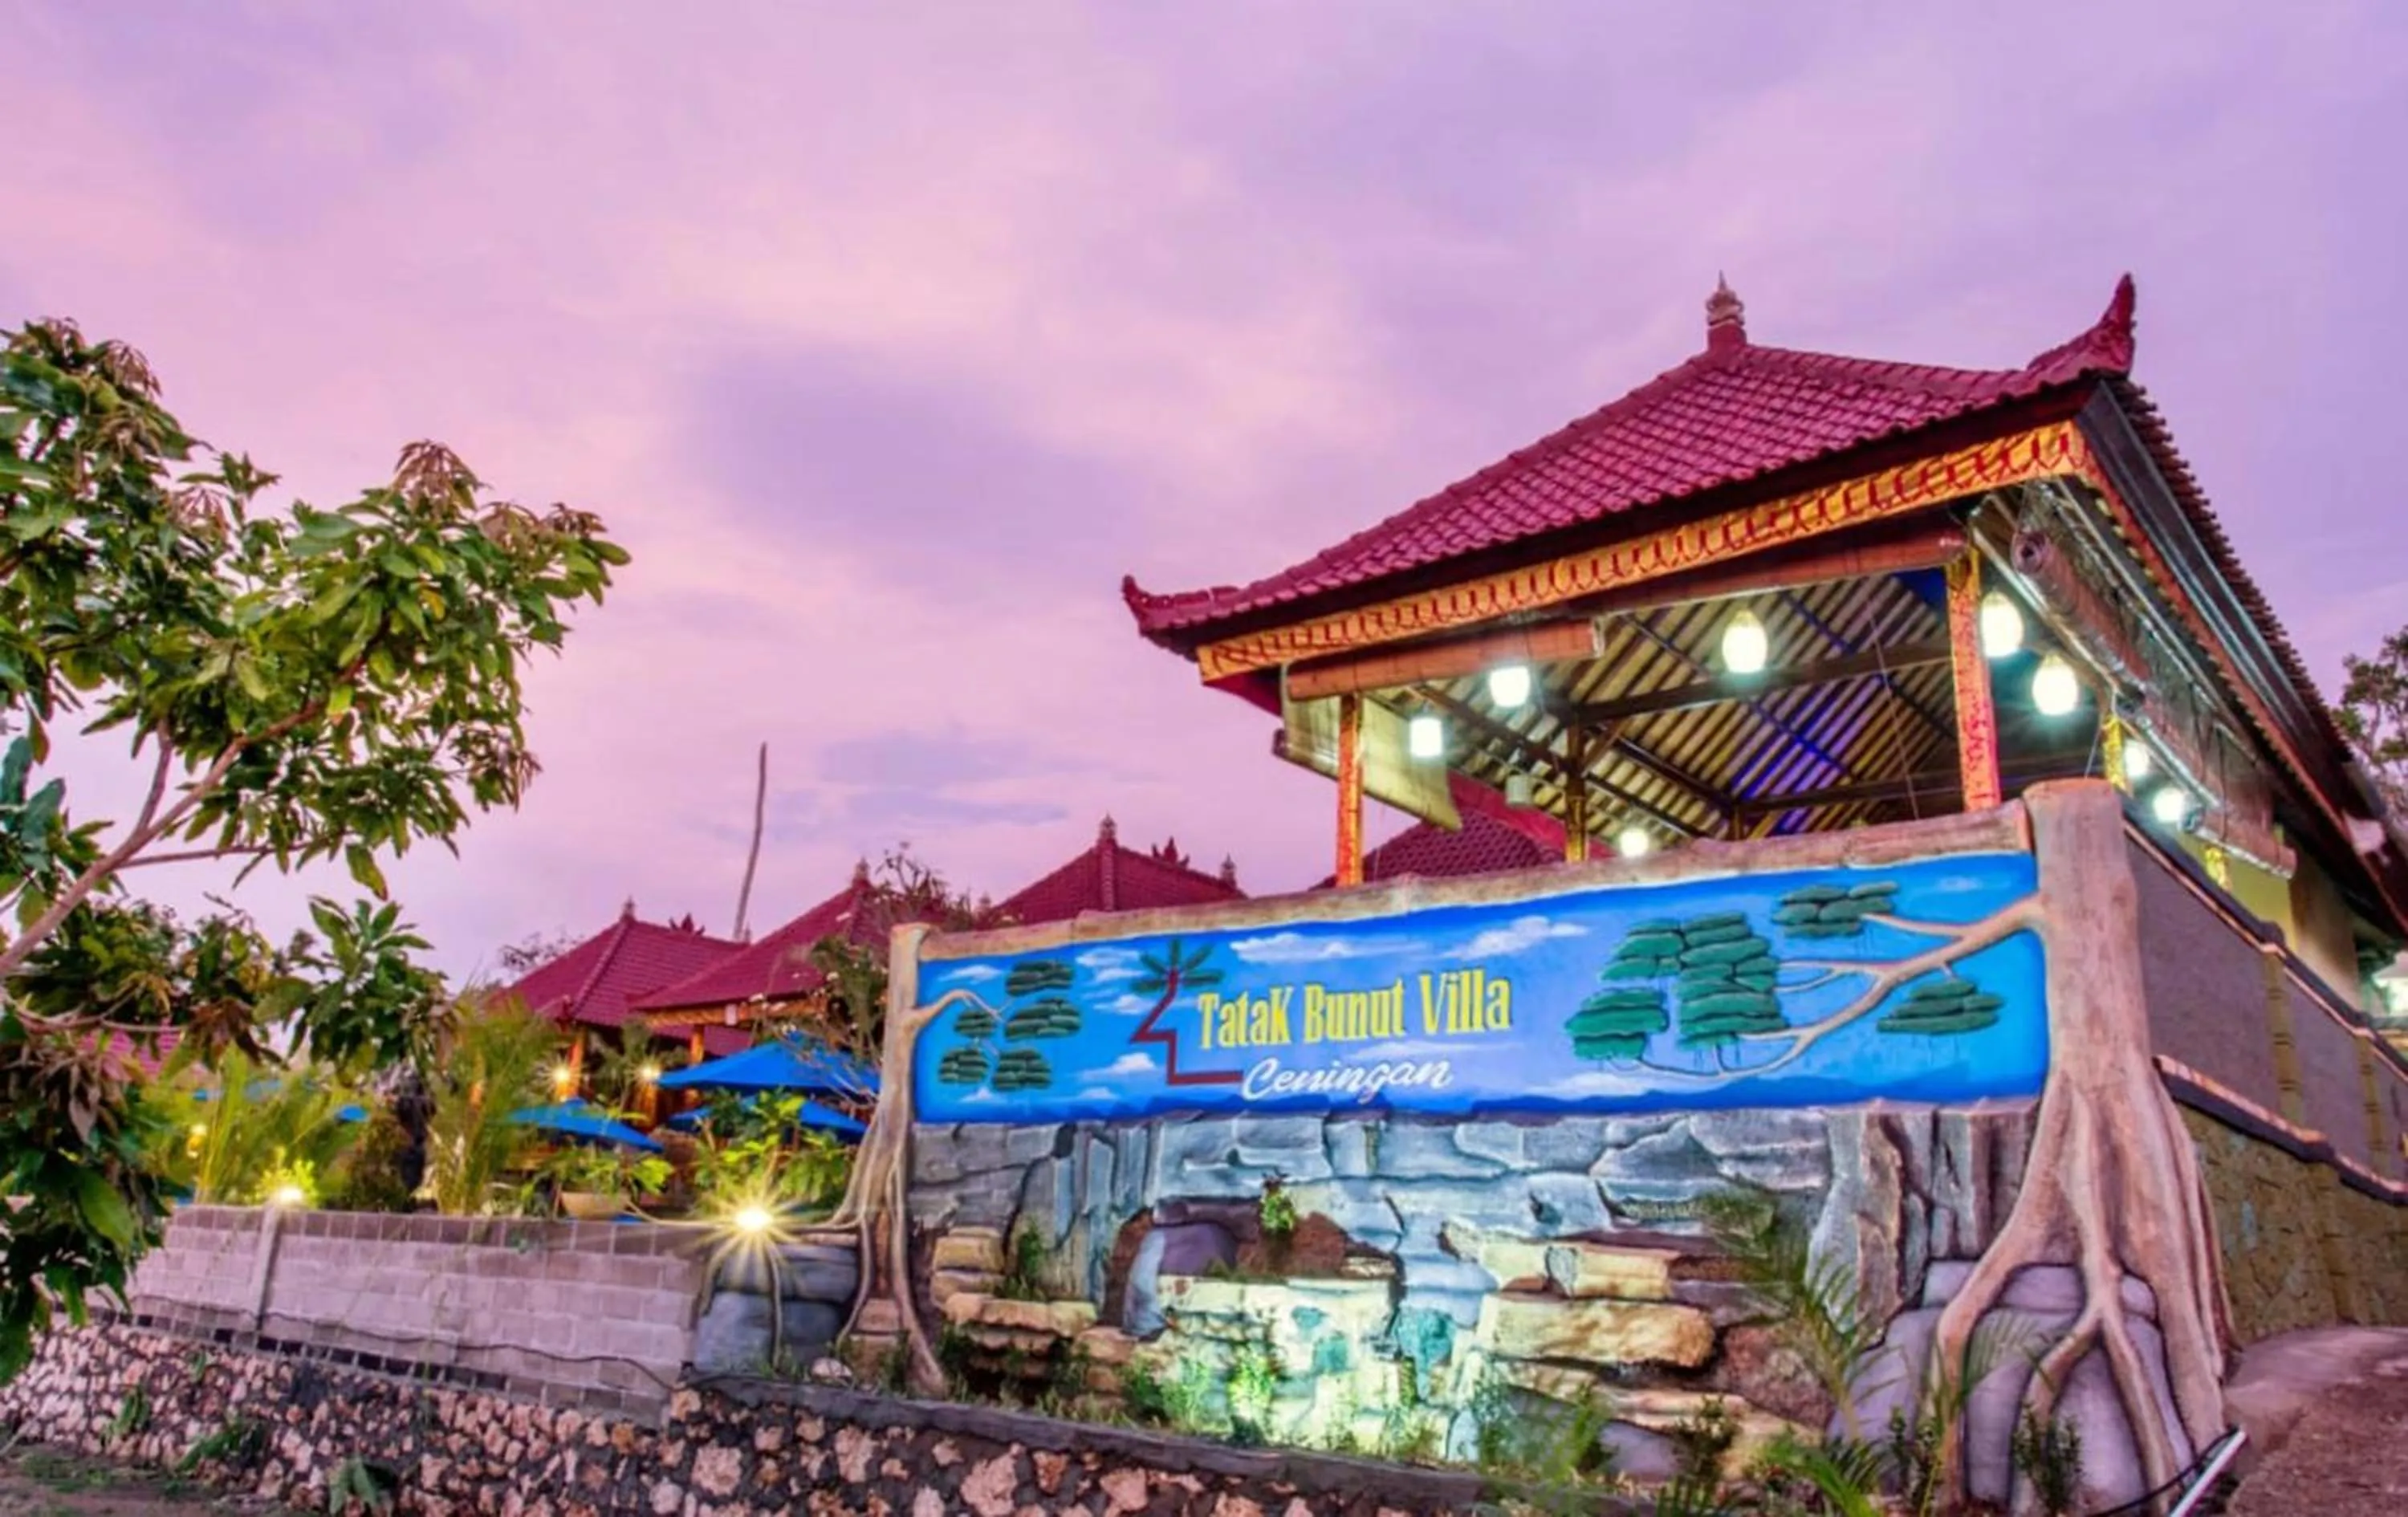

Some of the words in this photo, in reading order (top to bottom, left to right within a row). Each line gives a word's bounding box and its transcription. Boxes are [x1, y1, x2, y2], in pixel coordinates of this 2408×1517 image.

[1304, 978, 1405, 1044] Bunut
[1418, 968, 1511, 1035] Villa
[1242, 1057, 1454, 1104] Ceningan
